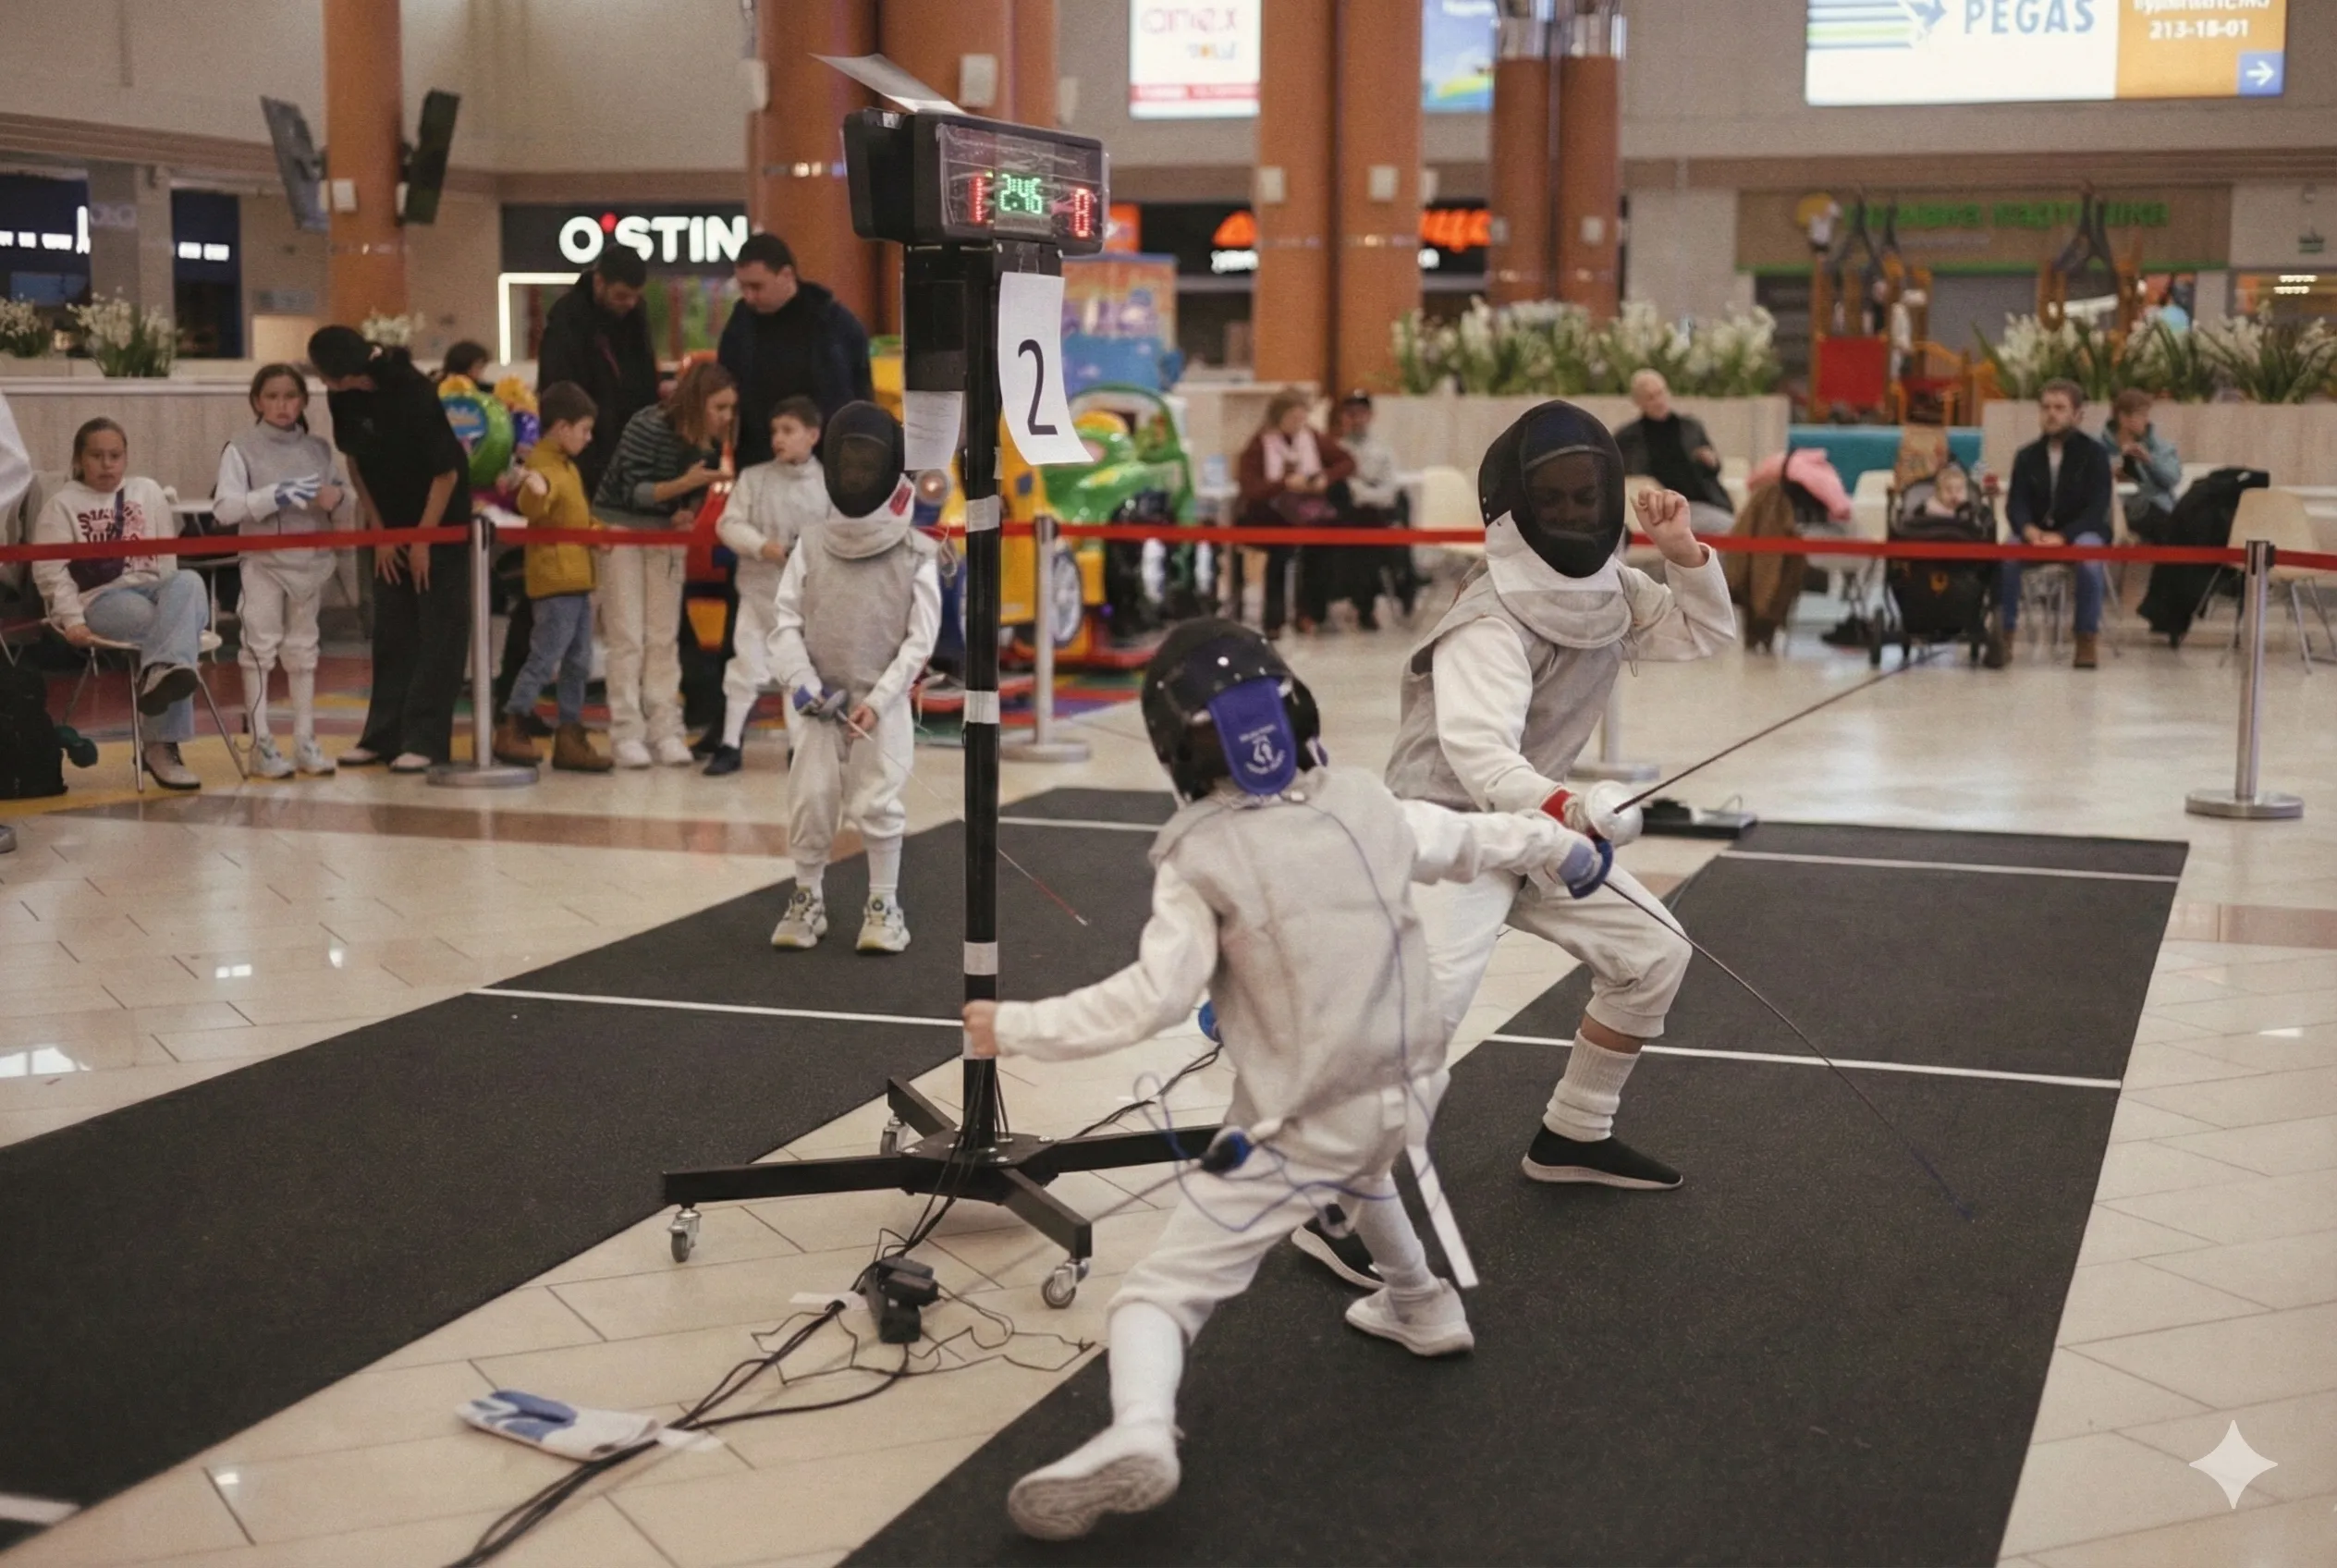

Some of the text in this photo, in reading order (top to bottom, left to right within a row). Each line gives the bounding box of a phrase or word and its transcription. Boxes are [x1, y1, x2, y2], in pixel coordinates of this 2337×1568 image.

[1964, 0, 2096, 34] PEGAS
[558, 213, 749, 264] O'STIN
[1017, 338, 1058, 435] 2
